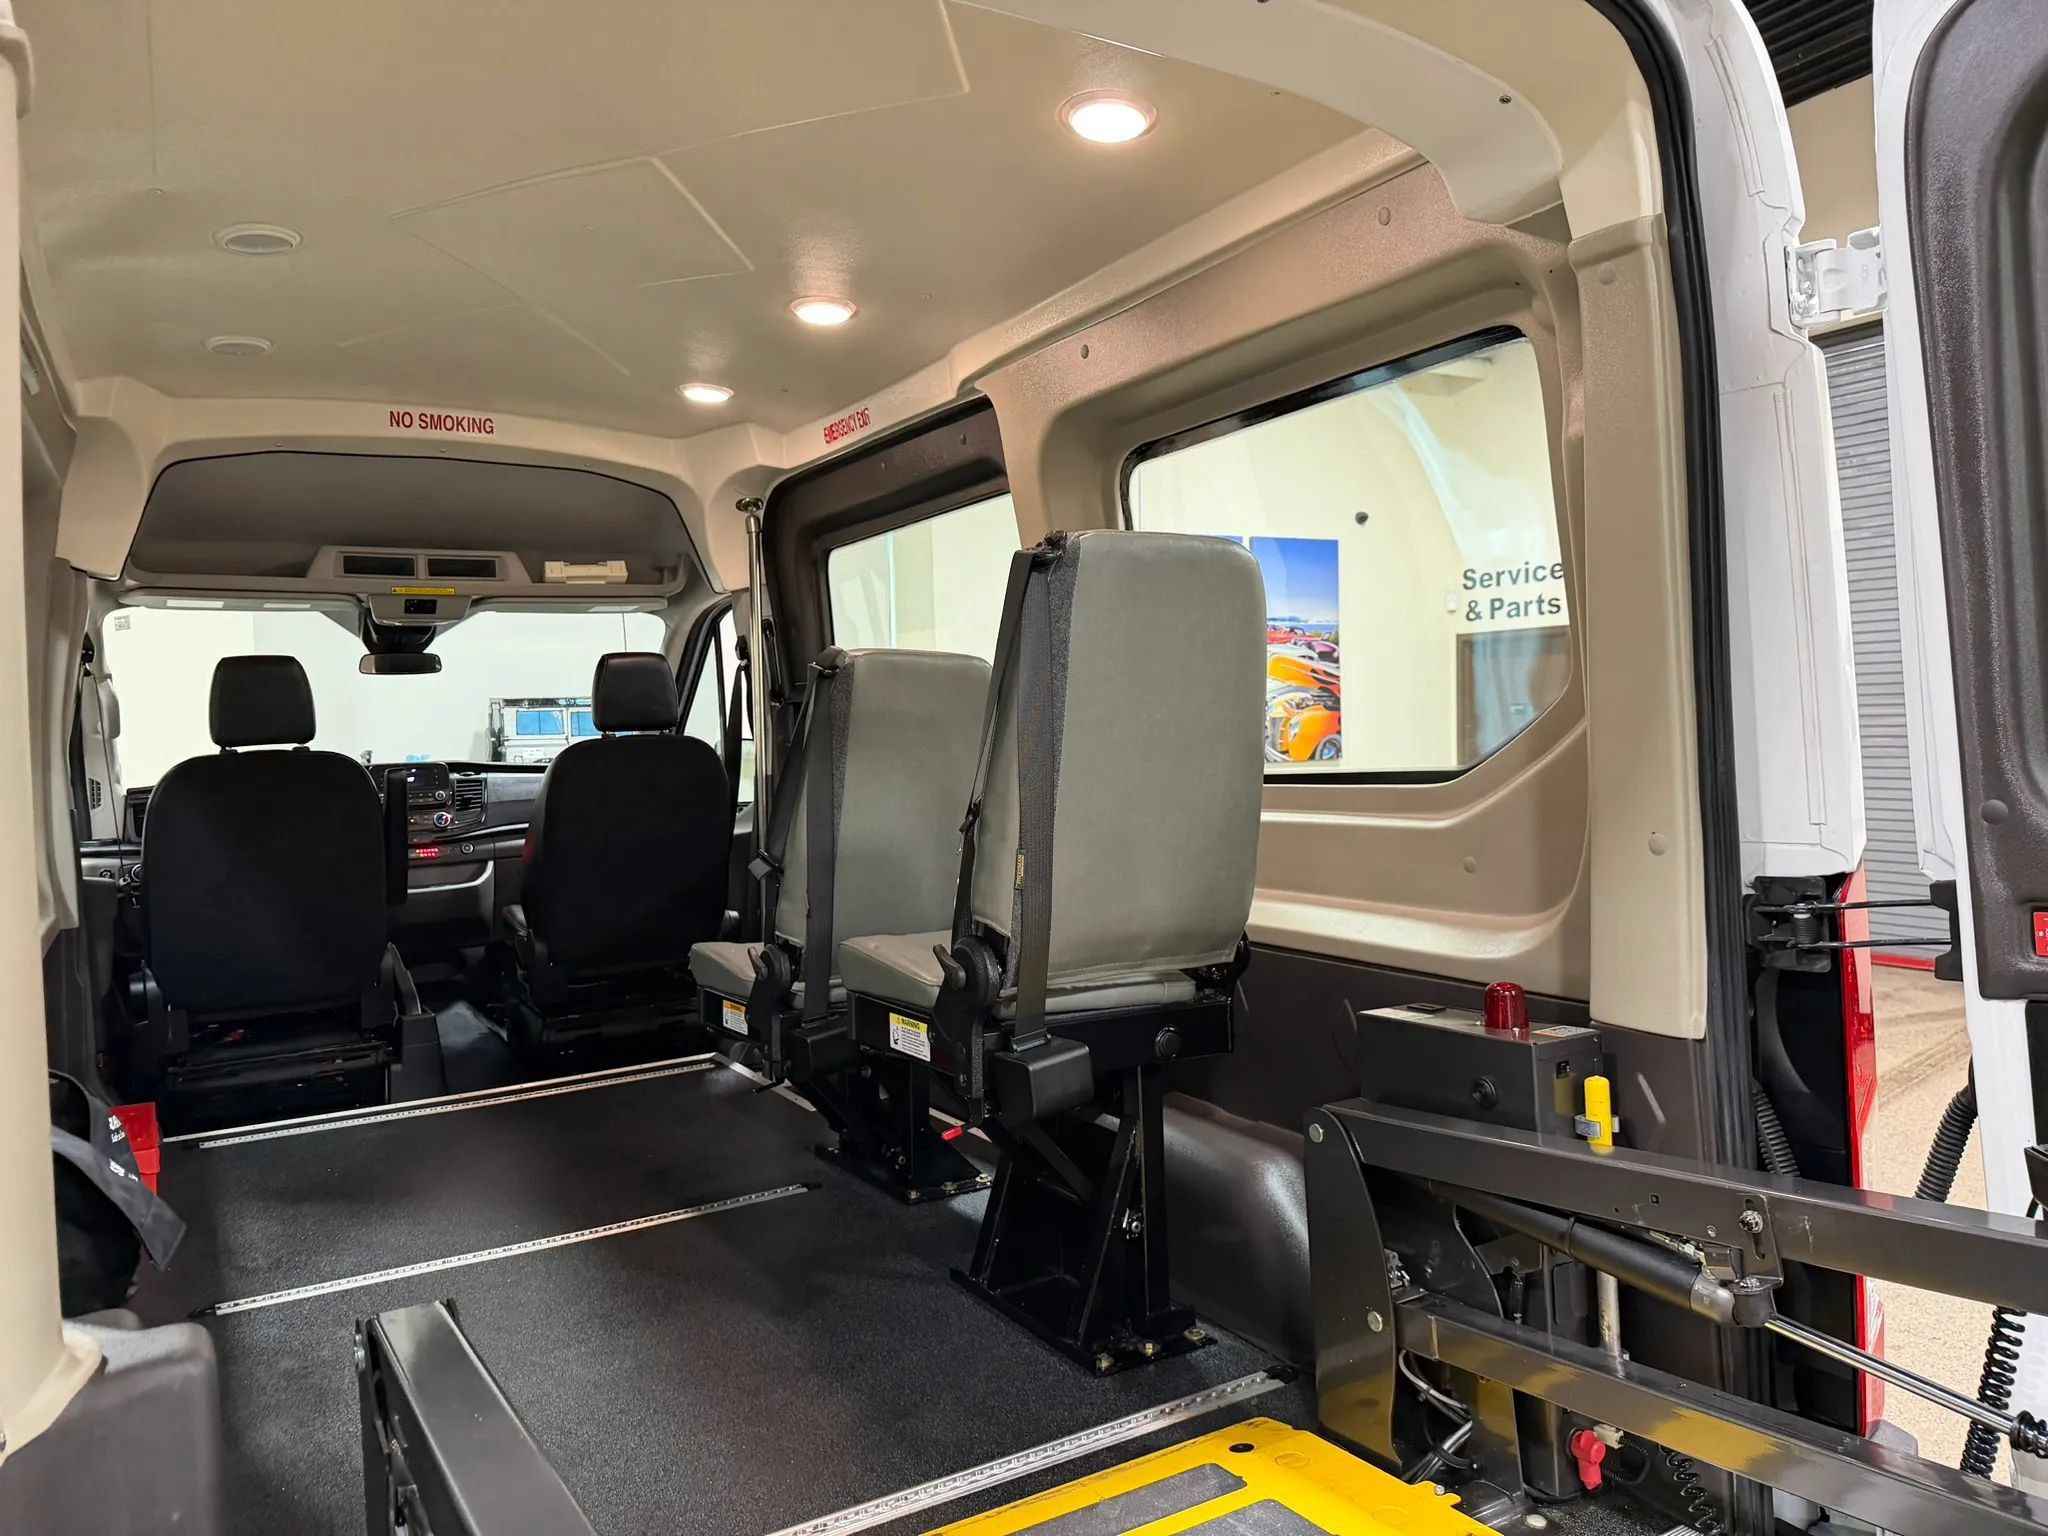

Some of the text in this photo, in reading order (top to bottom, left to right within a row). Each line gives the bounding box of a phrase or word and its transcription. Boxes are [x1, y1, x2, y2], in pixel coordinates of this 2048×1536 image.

[389, 410, 494, 435] NO SMOKING
[823, 407, 871, 444] EMERGENCY EXIT
[1462, 561, 1564, 591] Service
[1465, 592, 1562, 622] & Parts
[900, 1017, 921, 1031] WARNING
